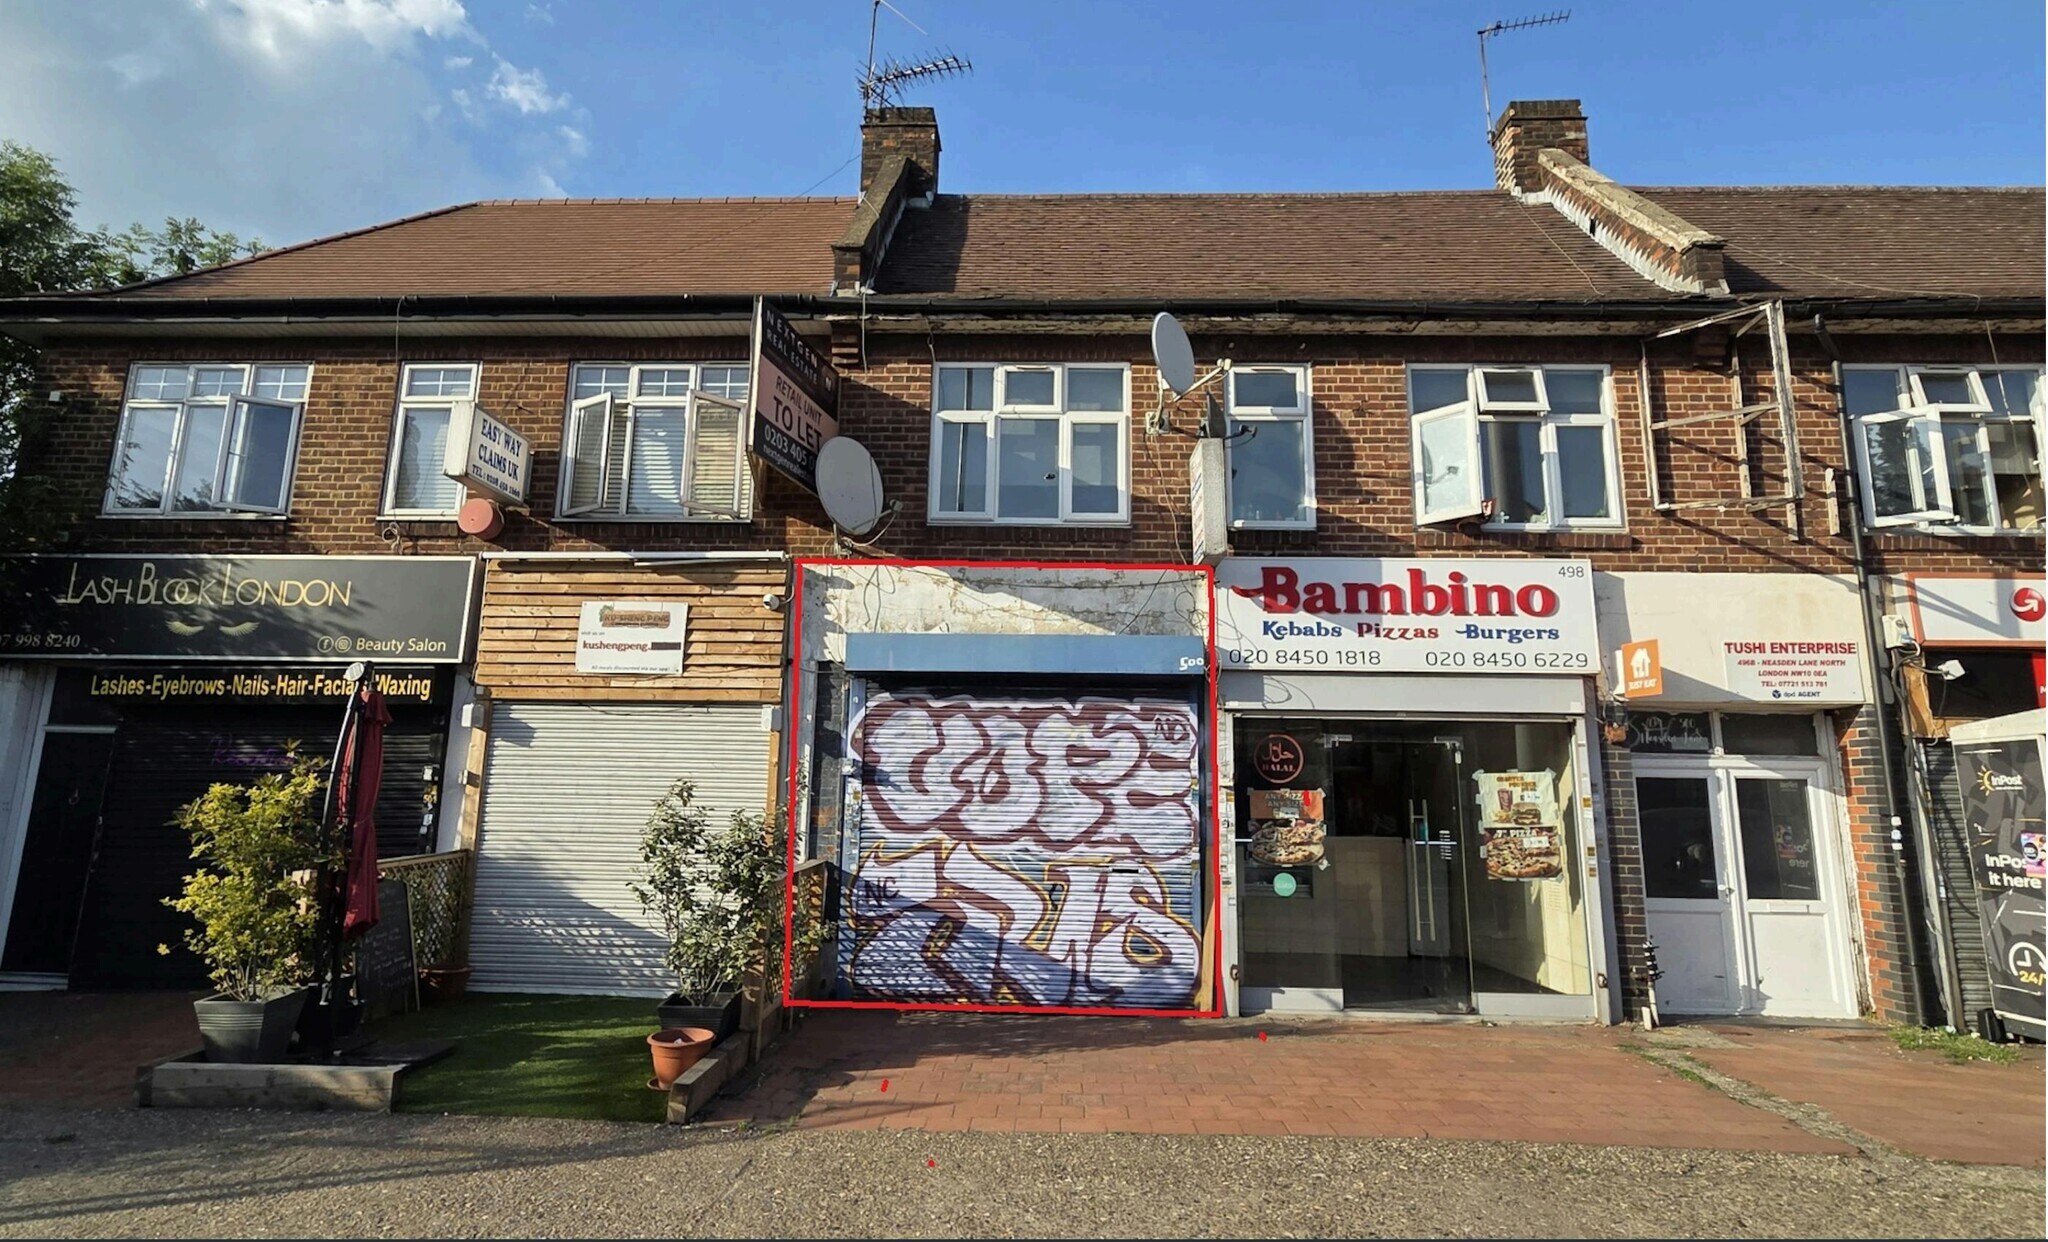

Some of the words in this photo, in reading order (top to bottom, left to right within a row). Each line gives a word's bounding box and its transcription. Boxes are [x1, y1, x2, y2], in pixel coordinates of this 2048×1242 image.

[766, 329, 788, 357] REAL
[791, 352, 817, 385] ESTATE
[775, 375, 802, 410] RETAIL
[803, 400, 823, 426] UNIT
[773, 394, 793, 432] TO
[797, 415, 823, 455] LET
[481, 418, 504, 445] EASY
[504, 431, 522, 457] WAY
[763, 424, 789, 453] 0203
[790, 443, 807, 466] 405
[478, 443, 507, 474] CLAIMS
[508, 460, 520, 481] UK
[1557, 565, 1586, 579] 498
[1230, 566, 1561, 619] Bambino
[15, 634, 41, 647] 998
[44, 633, 81, 648] 8240
[1261, 620, 1343, 641] Kebabs
[1356, 622, 1440, 641] Pizzas
[1456, 624, 1561, 644] Burgers
[355, 637, 404, 653] Beauty
[406, 637, 447, 652] Salon
[1724, 642, 1766, 654] TUSHI
[1769, 642, 1857, 655] ENTERPRISE
[1179, 655, 1206, 672] 500
[1229, 648, 1269, 665] 020
[1275, 648, 1329, 666] 8450
[1335, 649, 1382, 666] 1818
[1425, 650, 1466, 667] 020
[1472, 651, 1528, 668] 8450
[1533, 651, 1589, 669] 6229
[1262, 763, 1297, 772] HALAL
[1991, 774, 2023, 786] InPost
[1510, 829, 1536, 838] PIZZA
[1988, 871, 2001, 886] it
[2002, 873, 2043, 889] here
